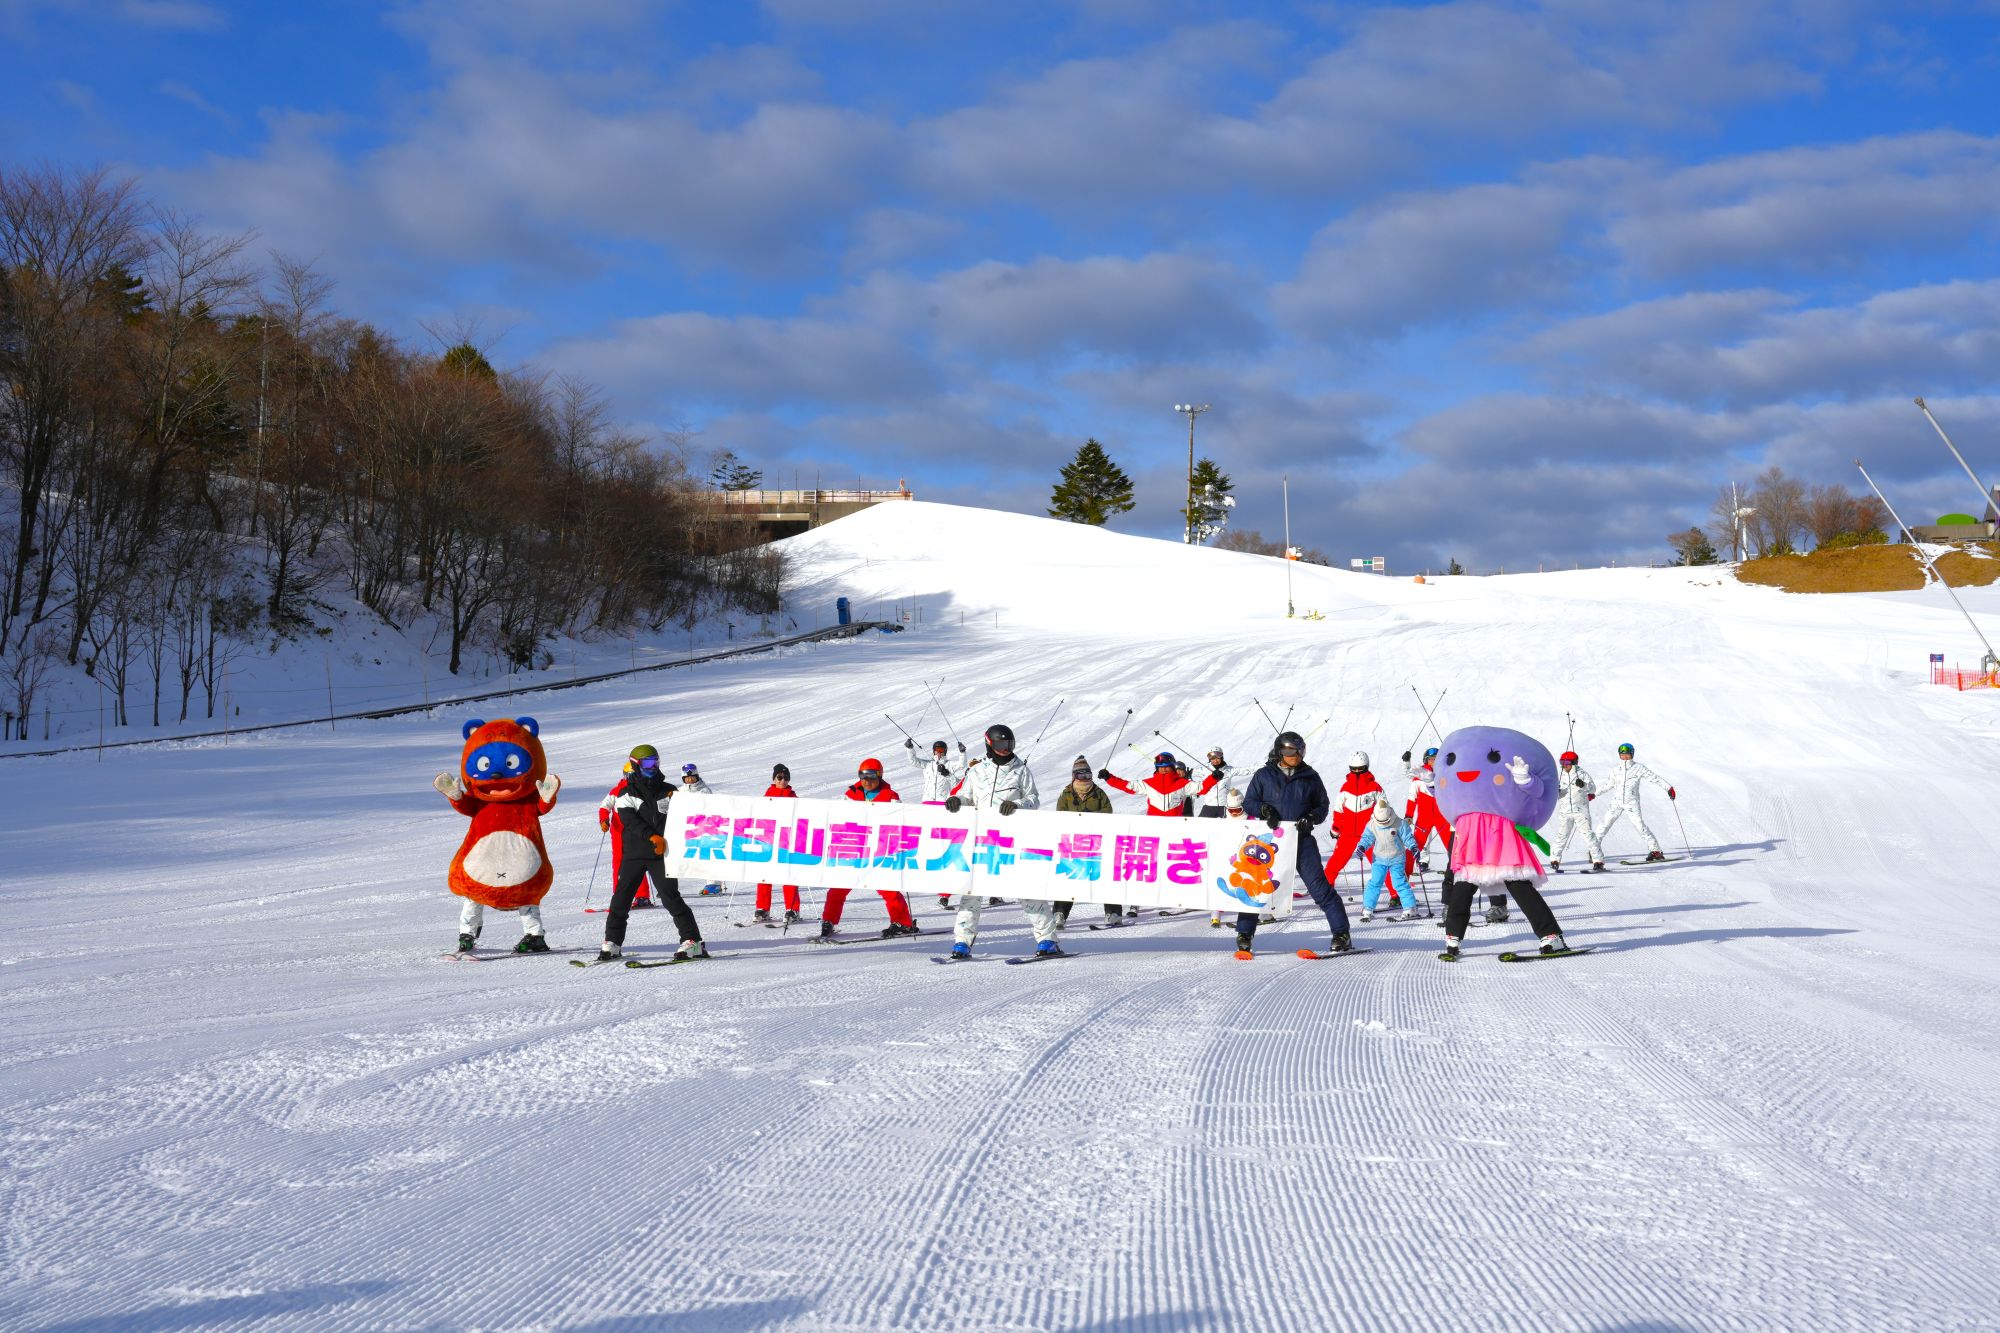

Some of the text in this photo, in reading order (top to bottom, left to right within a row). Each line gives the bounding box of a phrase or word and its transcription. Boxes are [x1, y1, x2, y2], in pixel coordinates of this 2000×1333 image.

[683, 814, 1208, 884] 茶臼山高原スキー場開き
